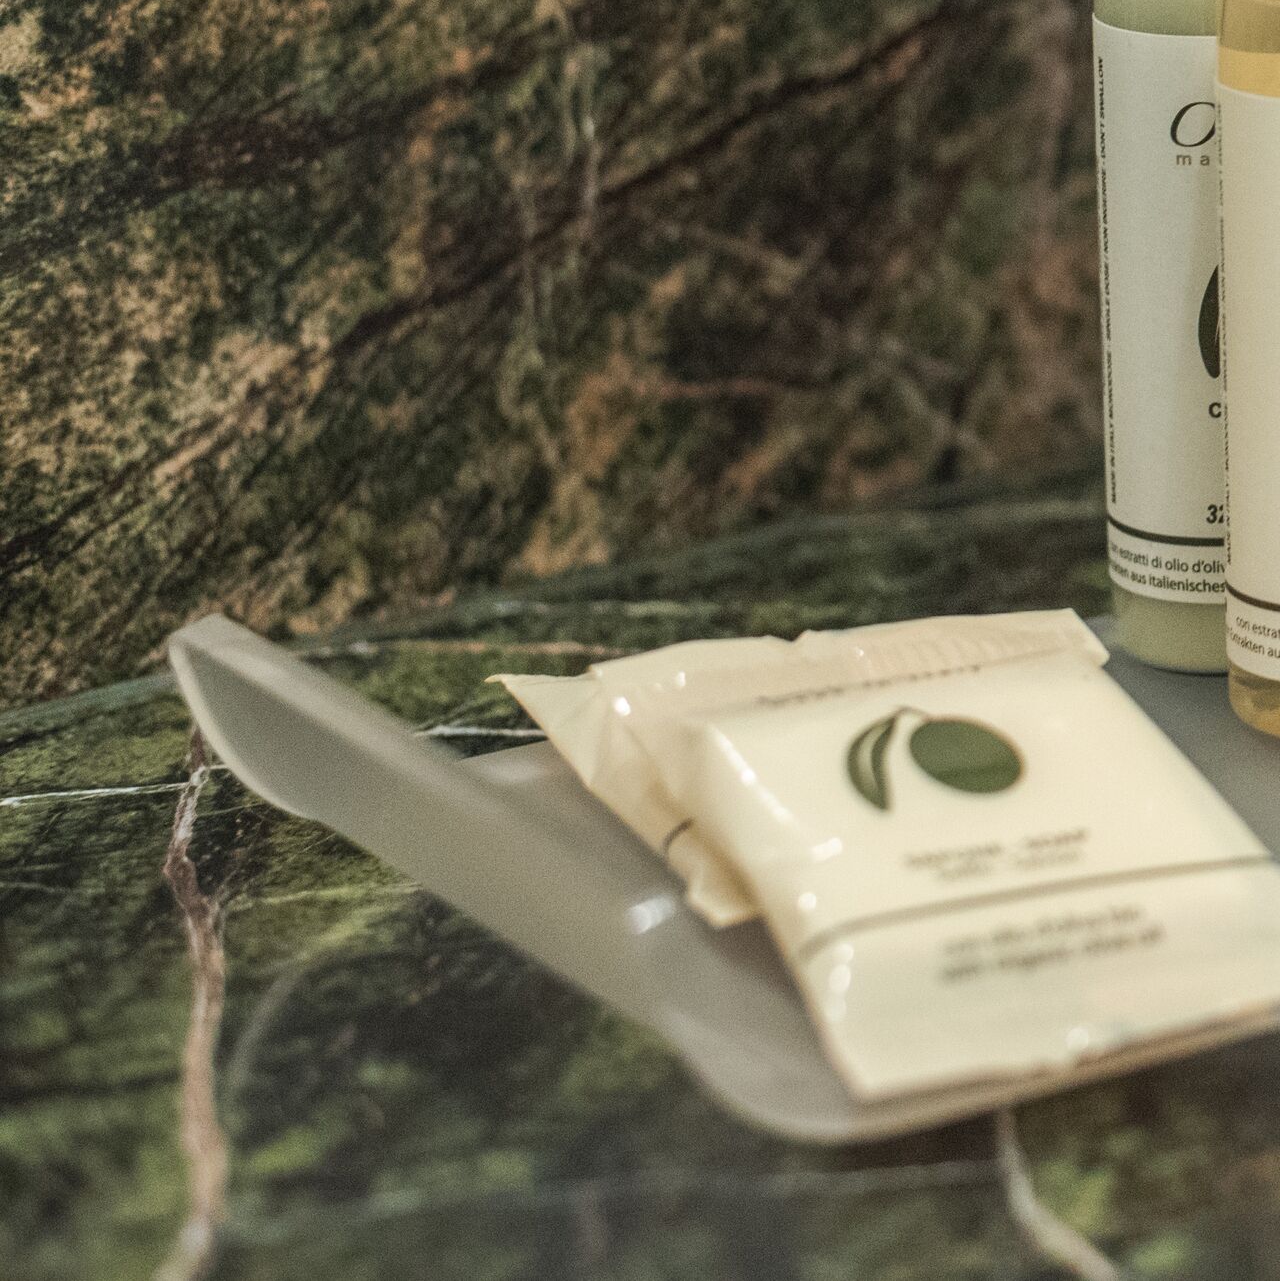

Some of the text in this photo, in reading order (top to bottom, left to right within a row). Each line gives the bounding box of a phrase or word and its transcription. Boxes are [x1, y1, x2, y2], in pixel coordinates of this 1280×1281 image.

[1175, 154, 1210, 166] ma
[1151, 556, 1162, 569] di
[1164, 559, 1189, 572] olio
[1191, 560, 1225, 574] d'oliv
[1148, 574, 1226, 593] italienisches
